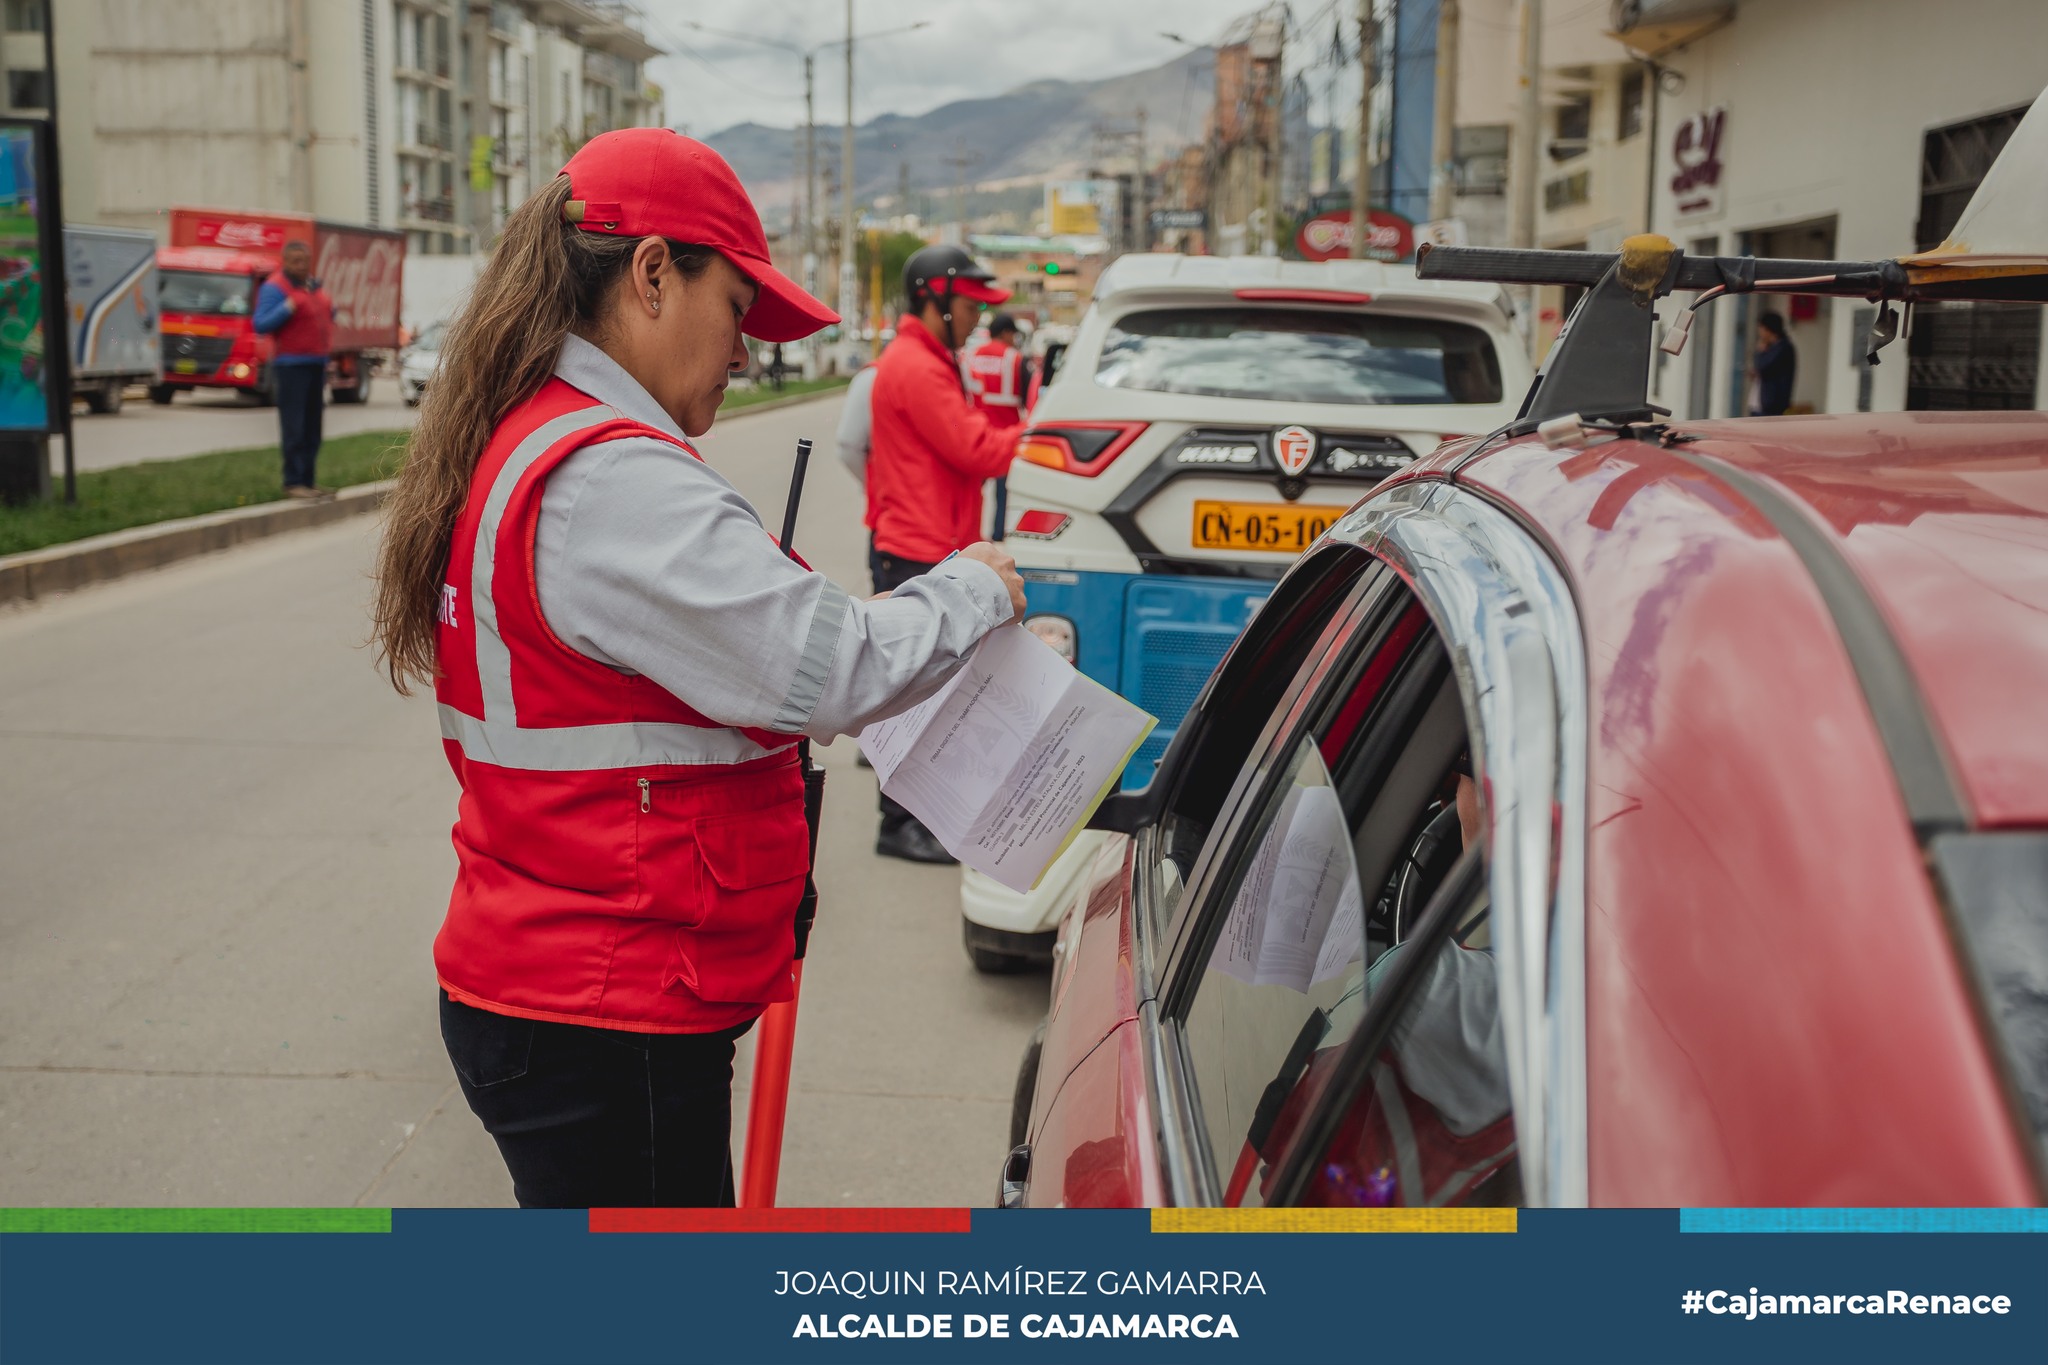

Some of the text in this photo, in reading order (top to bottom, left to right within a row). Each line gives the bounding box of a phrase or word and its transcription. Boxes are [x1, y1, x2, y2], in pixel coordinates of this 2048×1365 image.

[928, 671, 994, 763] FIRMA DIGITAL DEL TRAMITADOR DEL MAC
[1017, 816, 1042, 848] Municipalidad
[1038, 795, 1056, 819] Provincial
[1057, 766, 1077, 792] Cajamarca
[1075, 753, 1086, 766] 2023
